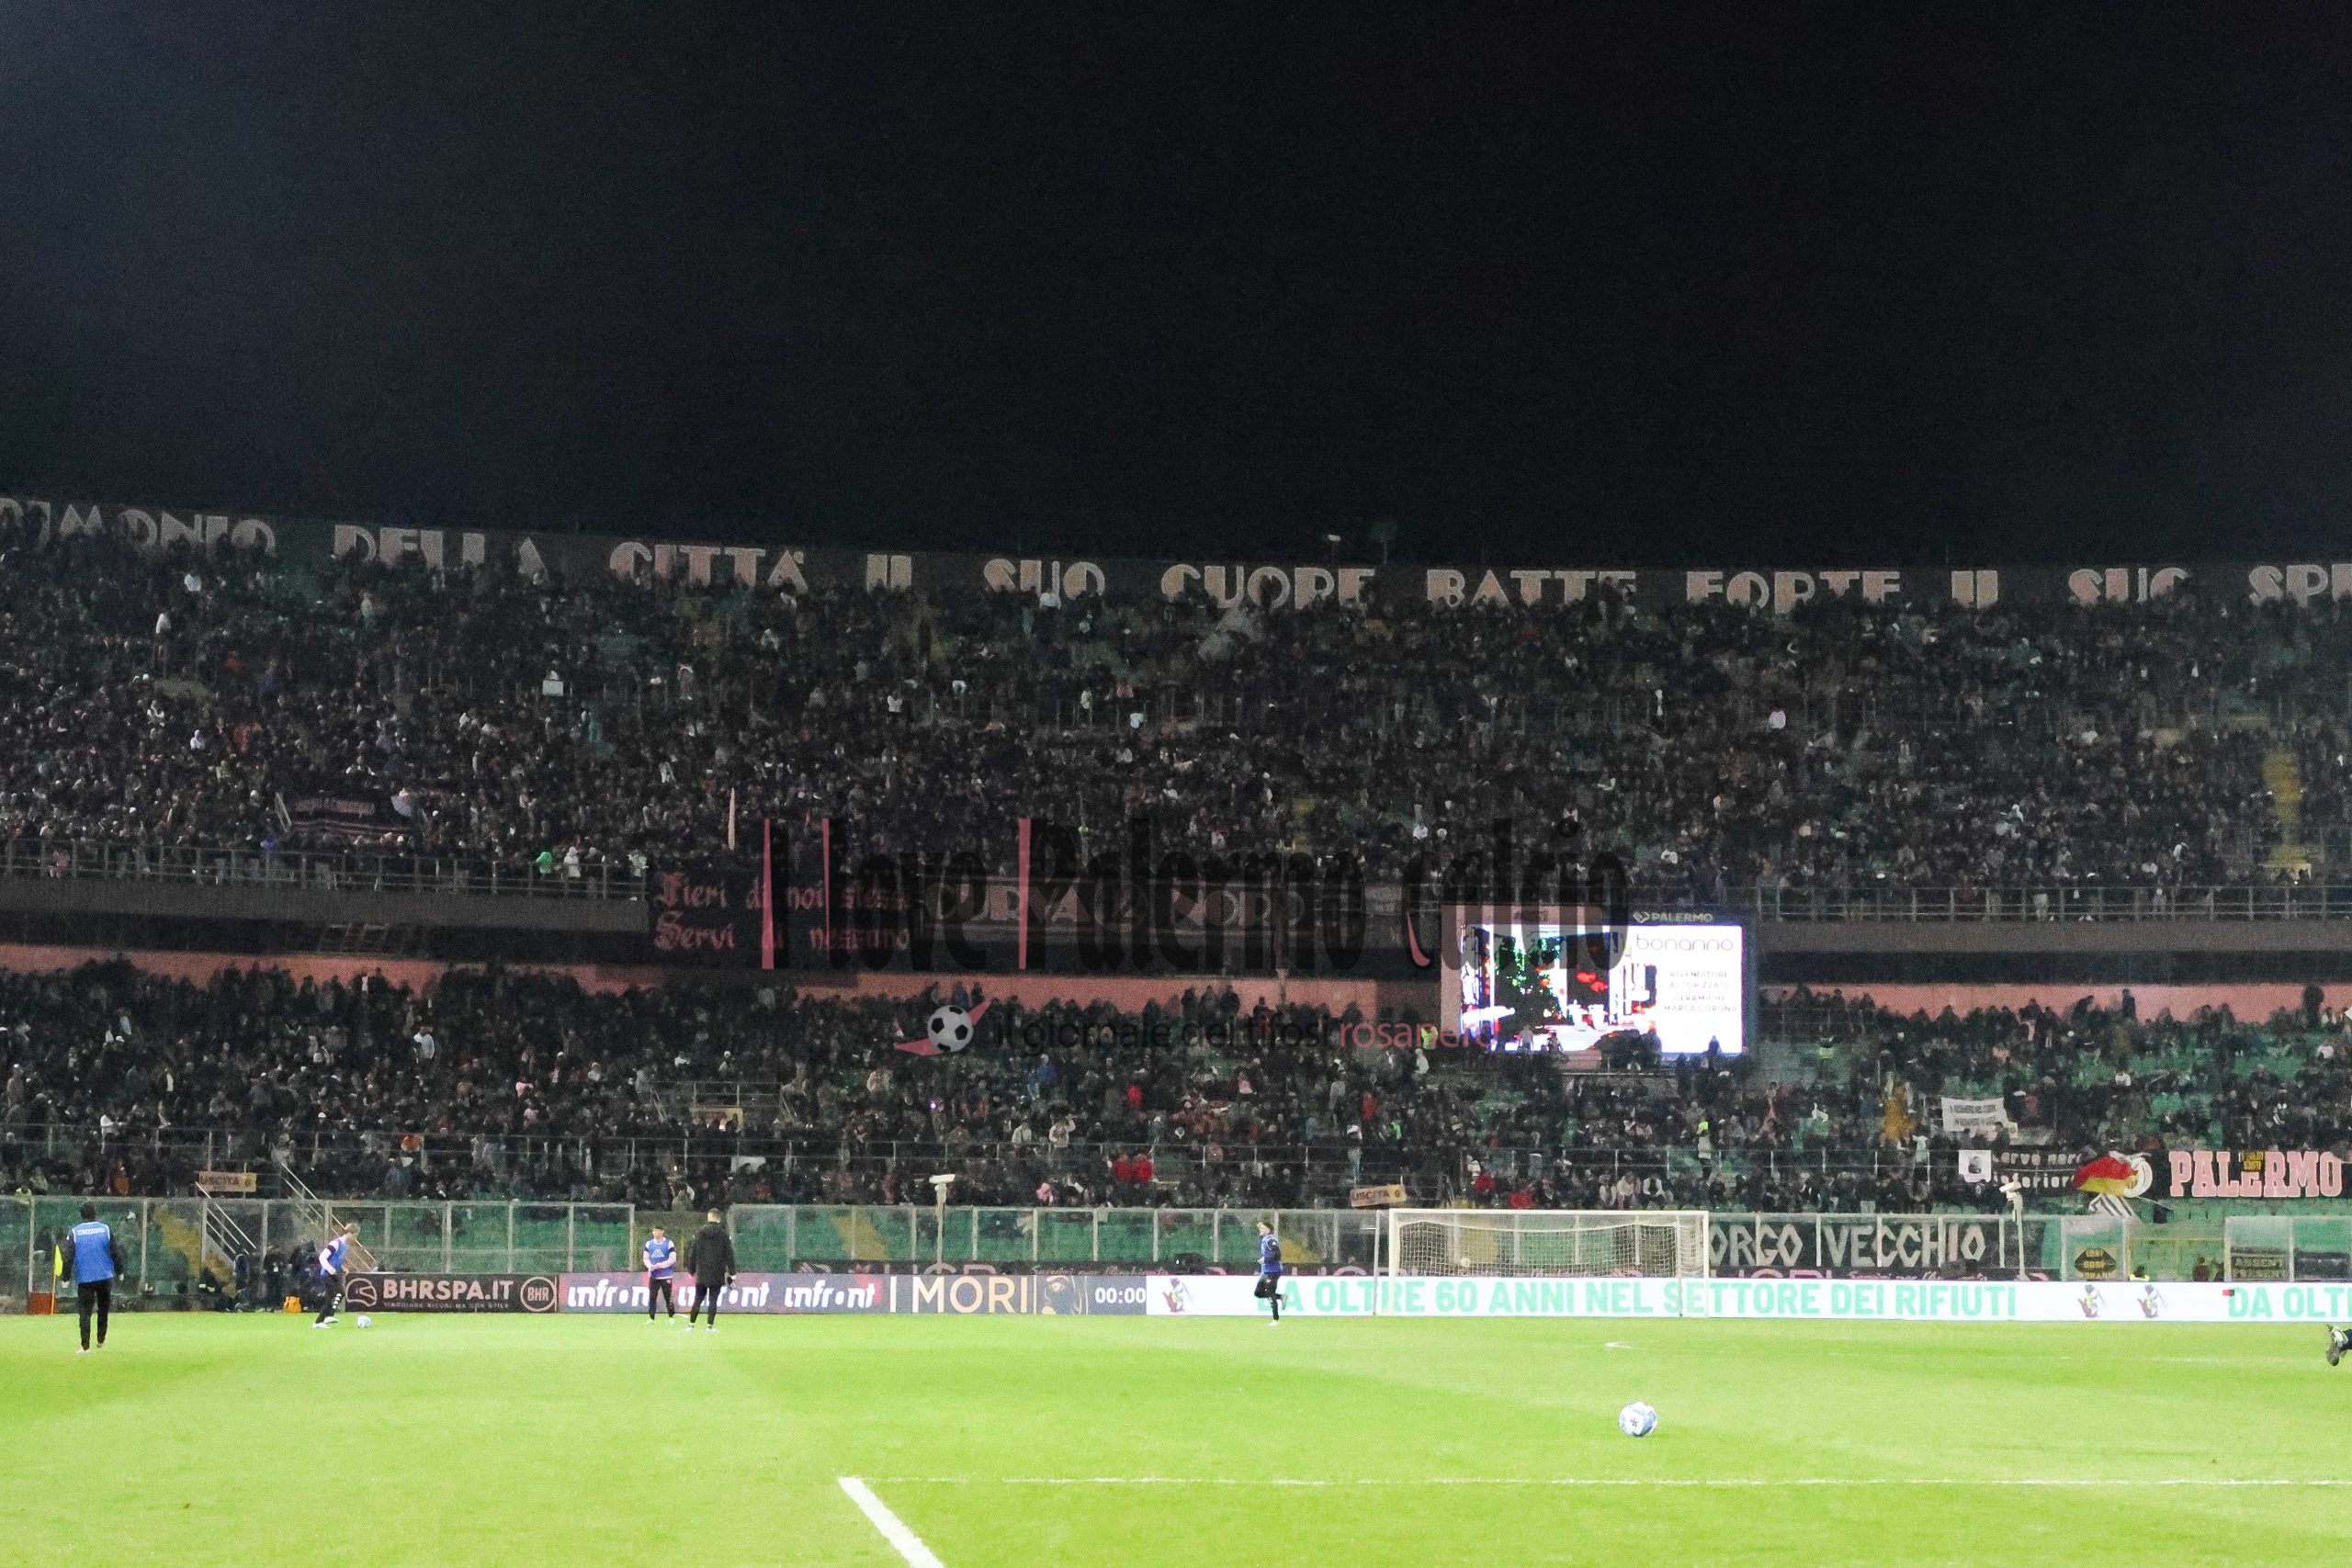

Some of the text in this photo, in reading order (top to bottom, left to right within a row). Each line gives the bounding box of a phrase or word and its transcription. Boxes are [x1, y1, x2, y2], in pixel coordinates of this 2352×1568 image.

[983, 558, 1105, 600] SUO
[1160, 564, 1375, 609] CUORE
[1427, 570, 1636, 614] BATTE
[1687, 571, 1901, 614] FORTE
[1652, 912, 1713, 922] PALERMO
[1636, 933, 1734, 951] bonanno
[1674, 994, 1725, 1002] CERAMICHE
[2168, 1151, 2342, 1197] PALERMO
[1823, 1224, 1985, 1268] VECCHIO
[382, 1279, 549, 1302] BHRSPA.IT BHR
[911, 1275, 1029, 1314] MORI
[1094, 1288, 1146, 1303] 00:00
[1314, 1280, 1426, 1314] OLTRE
[1436, 1281, 1477, 1314] 60
[1488, 1281, 1573, 1314] ANNI
[1577, 1281, 1654, 1314] NEL
[1664, 1282, 1821, 1315] SETTORE
[1832, 1283, 1887, 1316] DEI
[1902, 1284, 2016, 1318] RIFIUTI
[2228, 1288, 2274, 1319] DA
